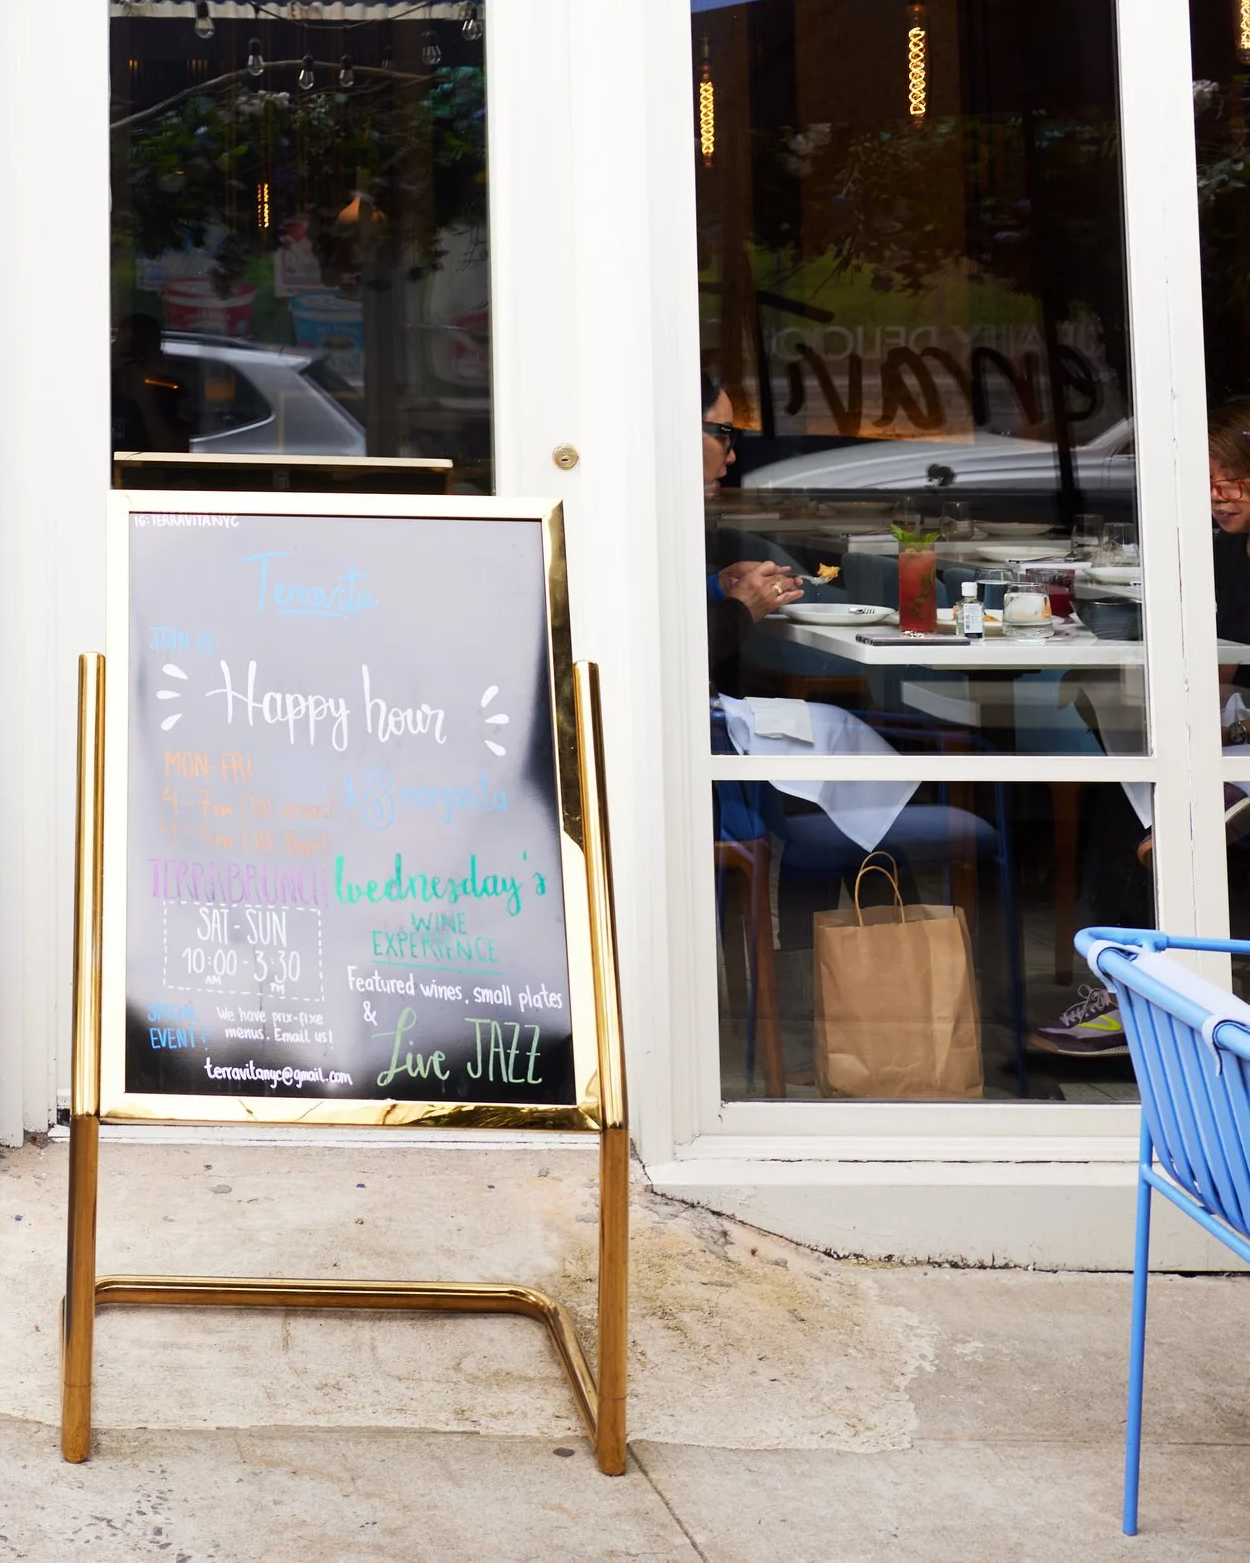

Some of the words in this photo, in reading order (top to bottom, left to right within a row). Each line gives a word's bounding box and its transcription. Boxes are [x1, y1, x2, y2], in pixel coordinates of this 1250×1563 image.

[205, 660, 350, 751] Happy
[362, 664, 447, 745] hour
[163, 749, 254, 785] MON-FRI
[196, 906, 230, 945] SAT
[245, 908, 288, 948] SUN
[410, 911, 469, 935] WINE
[370, 929, 500, 963] EXPERIENCE
[181, 947, 238, 976] 10:00
[253, 949, 302, 984] 3:30
[205, 975, 222, 986] AM
[269, 982, 286, 996] PM
[347, 965, 415, 996] Featured
[473, 983, 513, 1007] small
[518, 982, 564, 1013] plates
[215, 1006, 235, 1022] We
[237, 1007, 267, 1024] have
[272, 1010, 324, 1027] prix-fixe
[362, 1000, 379, 1026] &
[224, 1027, 271, 1041] menus.
[273, 1028, 309, 1045] Email
[314, 1030, 334, 1050] us!
[370, 1006, 451, 1087] Live
[463, 1016, 543, 1085] JAZZ
[203, 1056, 354, 1088] terravitanyc@gmail.com
